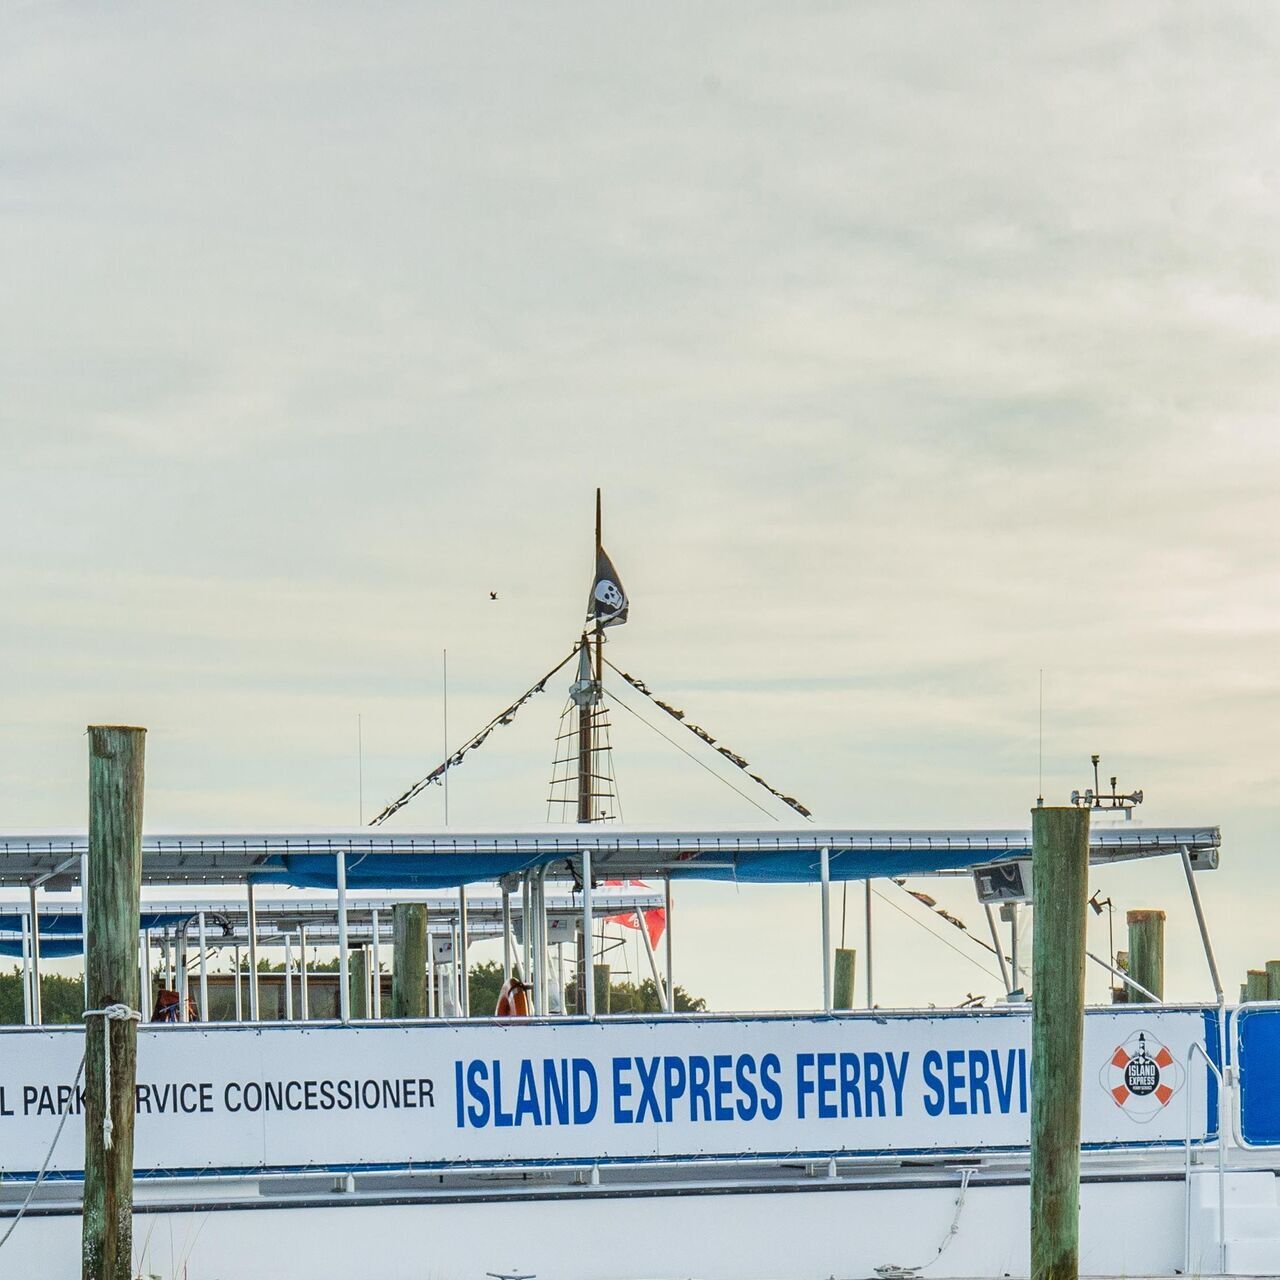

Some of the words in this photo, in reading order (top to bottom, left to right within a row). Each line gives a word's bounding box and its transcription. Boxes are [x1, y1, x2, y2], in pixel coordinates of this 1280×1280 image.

[1128, 1064, 1156, 1077] ISLAND
[1129, 1076, 1156, 1086] EXPRESS
[23, 1084, 86, 1116] PARK
[135, 1083, 214, 1114] RVICE
[224, 1078, 436, 1113] CONCESSIONER
[454, 1057, 599, 1129] ISLAND
[610, 1052, 783, 1126] EXPRESS
[796, 1050, 910, 1120] FERRY
[922, 1047, 1032, 1118] SERVI
